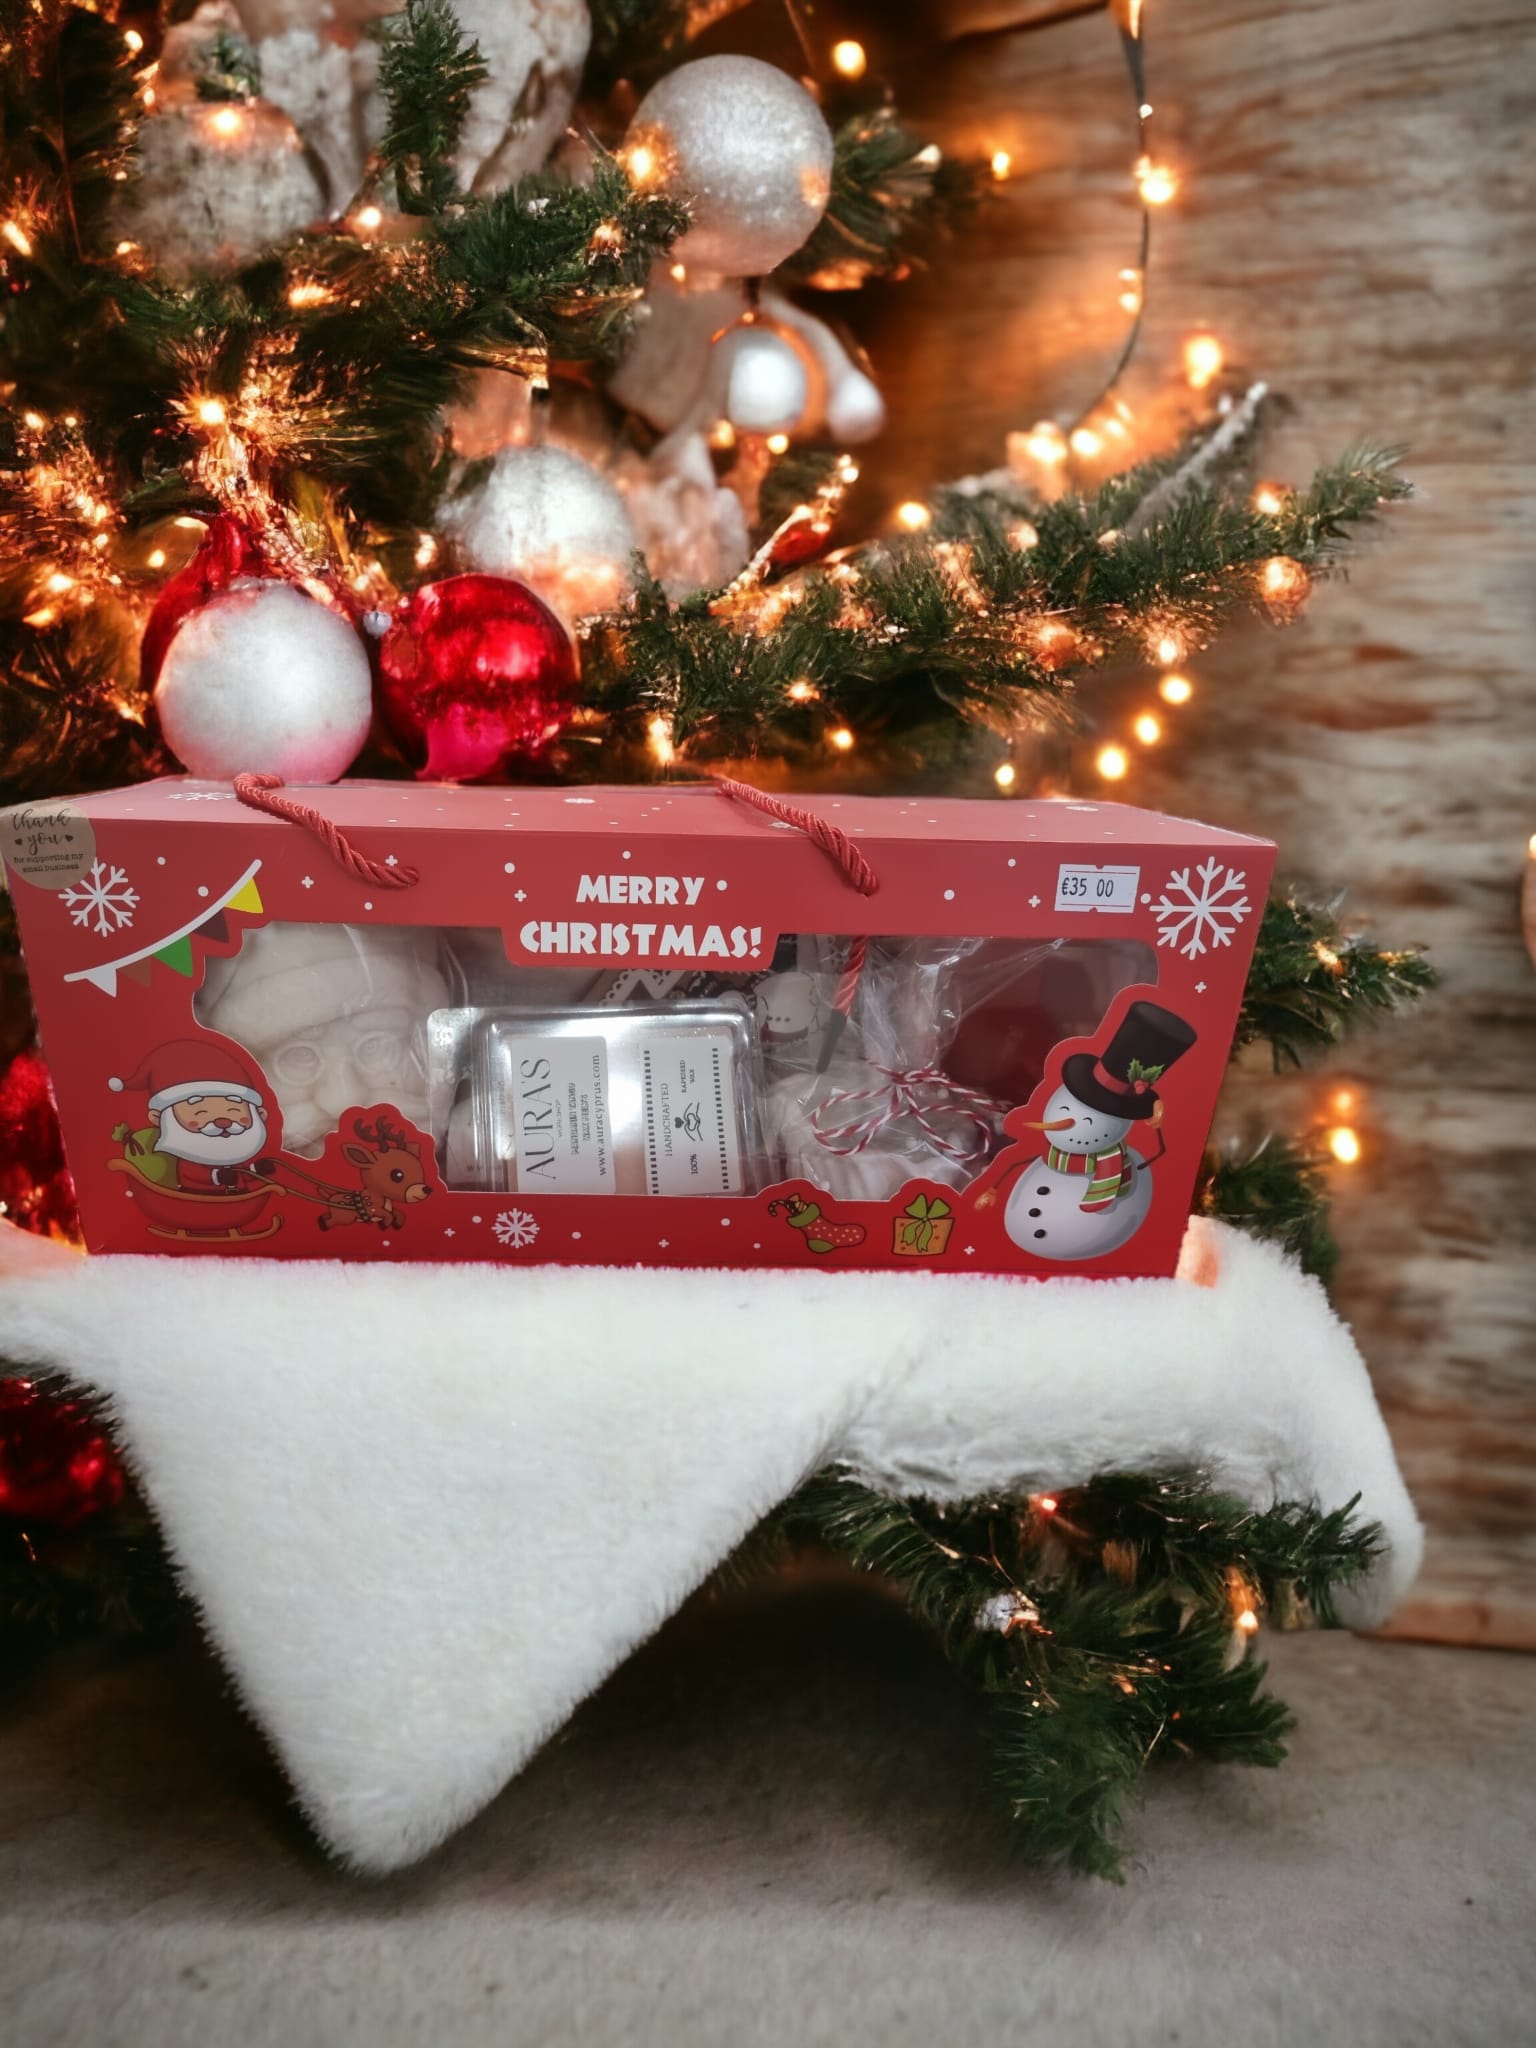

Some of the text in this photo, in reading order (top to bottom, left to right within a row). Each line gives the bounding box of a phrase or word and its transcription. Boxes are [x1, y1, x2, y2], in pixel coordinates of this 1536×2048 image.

[13, 808, 71, 830] thank
[27, 832, 63, 856] you
[575, 874, 705, 905] MERRY
[1061, 876, 1114, 898] €35 00
[519, 920, 762, 959] CHRISTMAS!
[679, 1059, 687, 1093] RAPESEED
[520, 1058, 557, 1180] AURA'S
[592, 1055, 607, 1176] www.auracyprus.com
[660, 1082, 673, 1157] HANDCRAFTED
[689, 1153, 699, 1175] 100%
